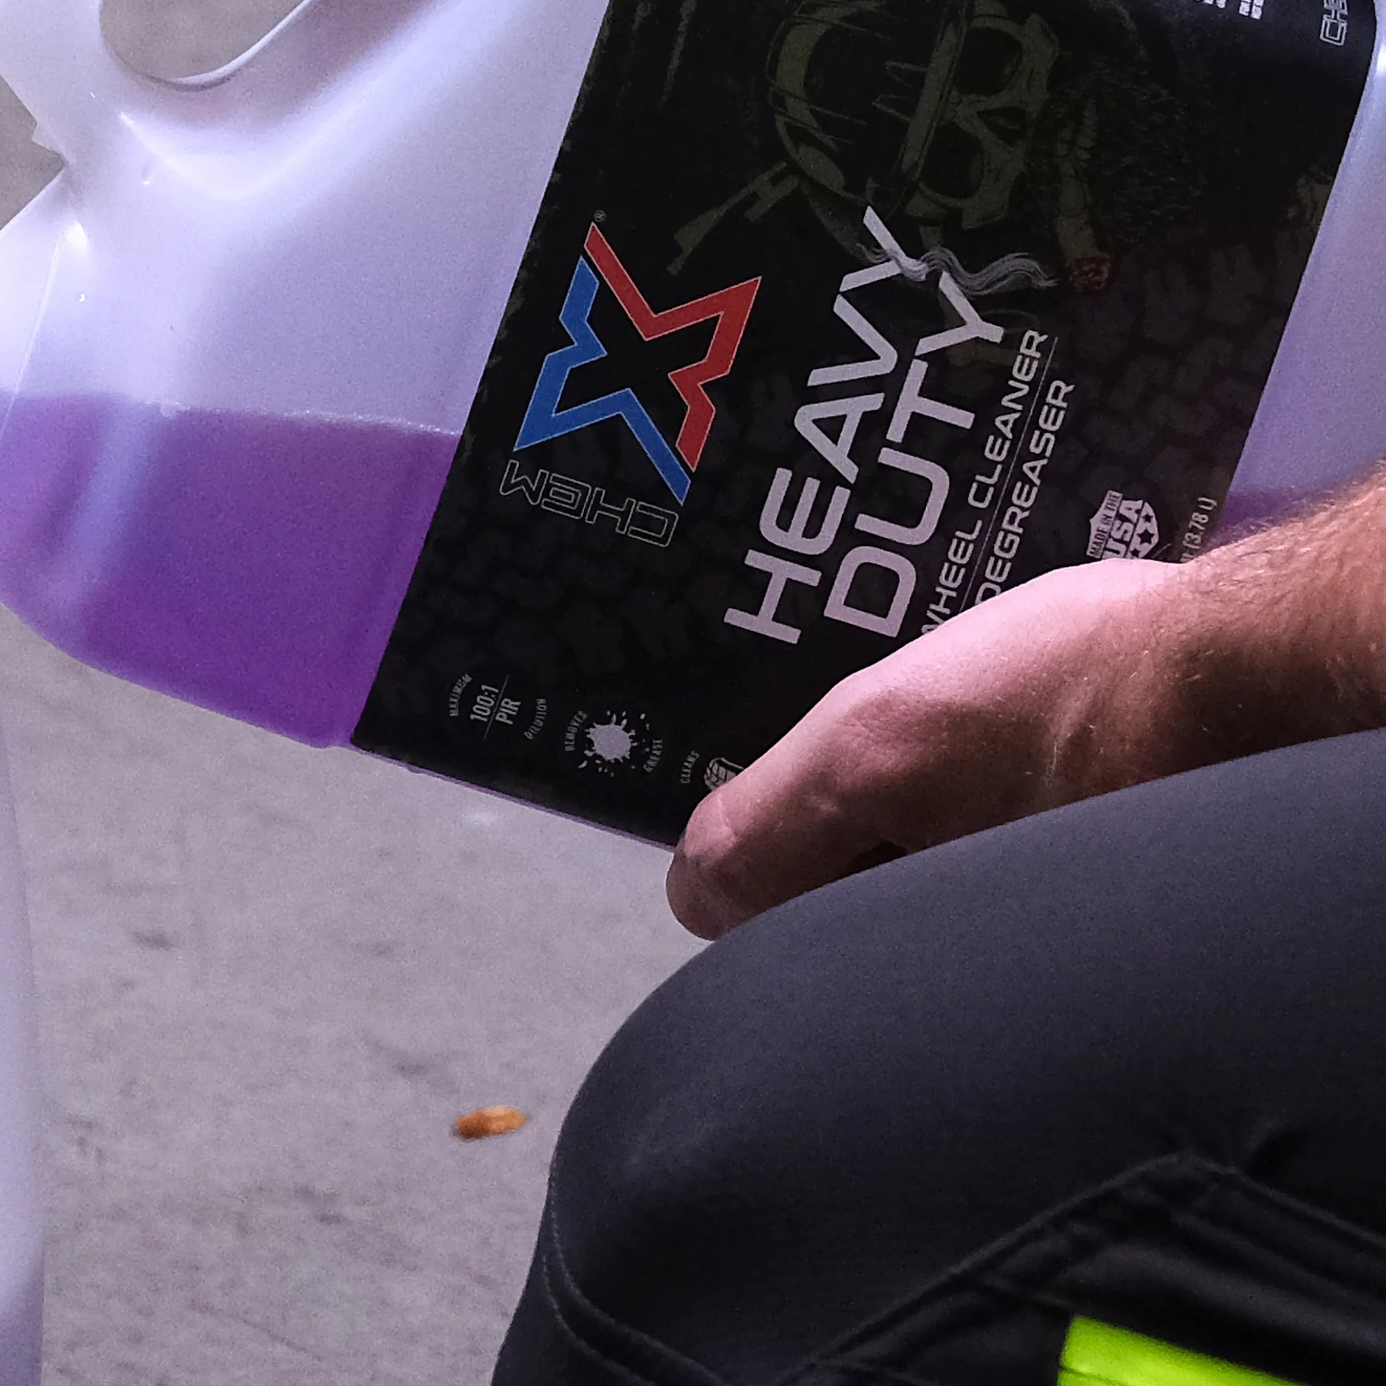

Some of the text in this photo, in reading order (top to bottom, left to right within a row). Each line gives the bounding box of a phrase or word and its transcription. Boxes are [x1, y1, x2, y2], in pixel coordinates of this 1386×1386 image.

[724, 206, 928, 645] HEAVY
[824, 272, 1004, 638] DUTY
[920, 327, 1049, 633] WHEEL CLEANER
[976, 377, 1075, 598] DEGREASER
[497, 458, 680, 548] CHEM
[1089, 493, 1120, 557] MADE IN THE
[1102, 500, 1143, 558] USA
[1182, 511, 1210, 547] (3.78
[449, 673, 473, 716] MAXIMUM
[469, 682, 499, 725] 100:1
[495, 696, 521, 726] PIR
[523, 698, 547, 740] DILUTION
[564, 710, 588, 751] REMOVES
[642, 738, 663, 773] GREASE
[680, 749, 700, 783] CLEANS
